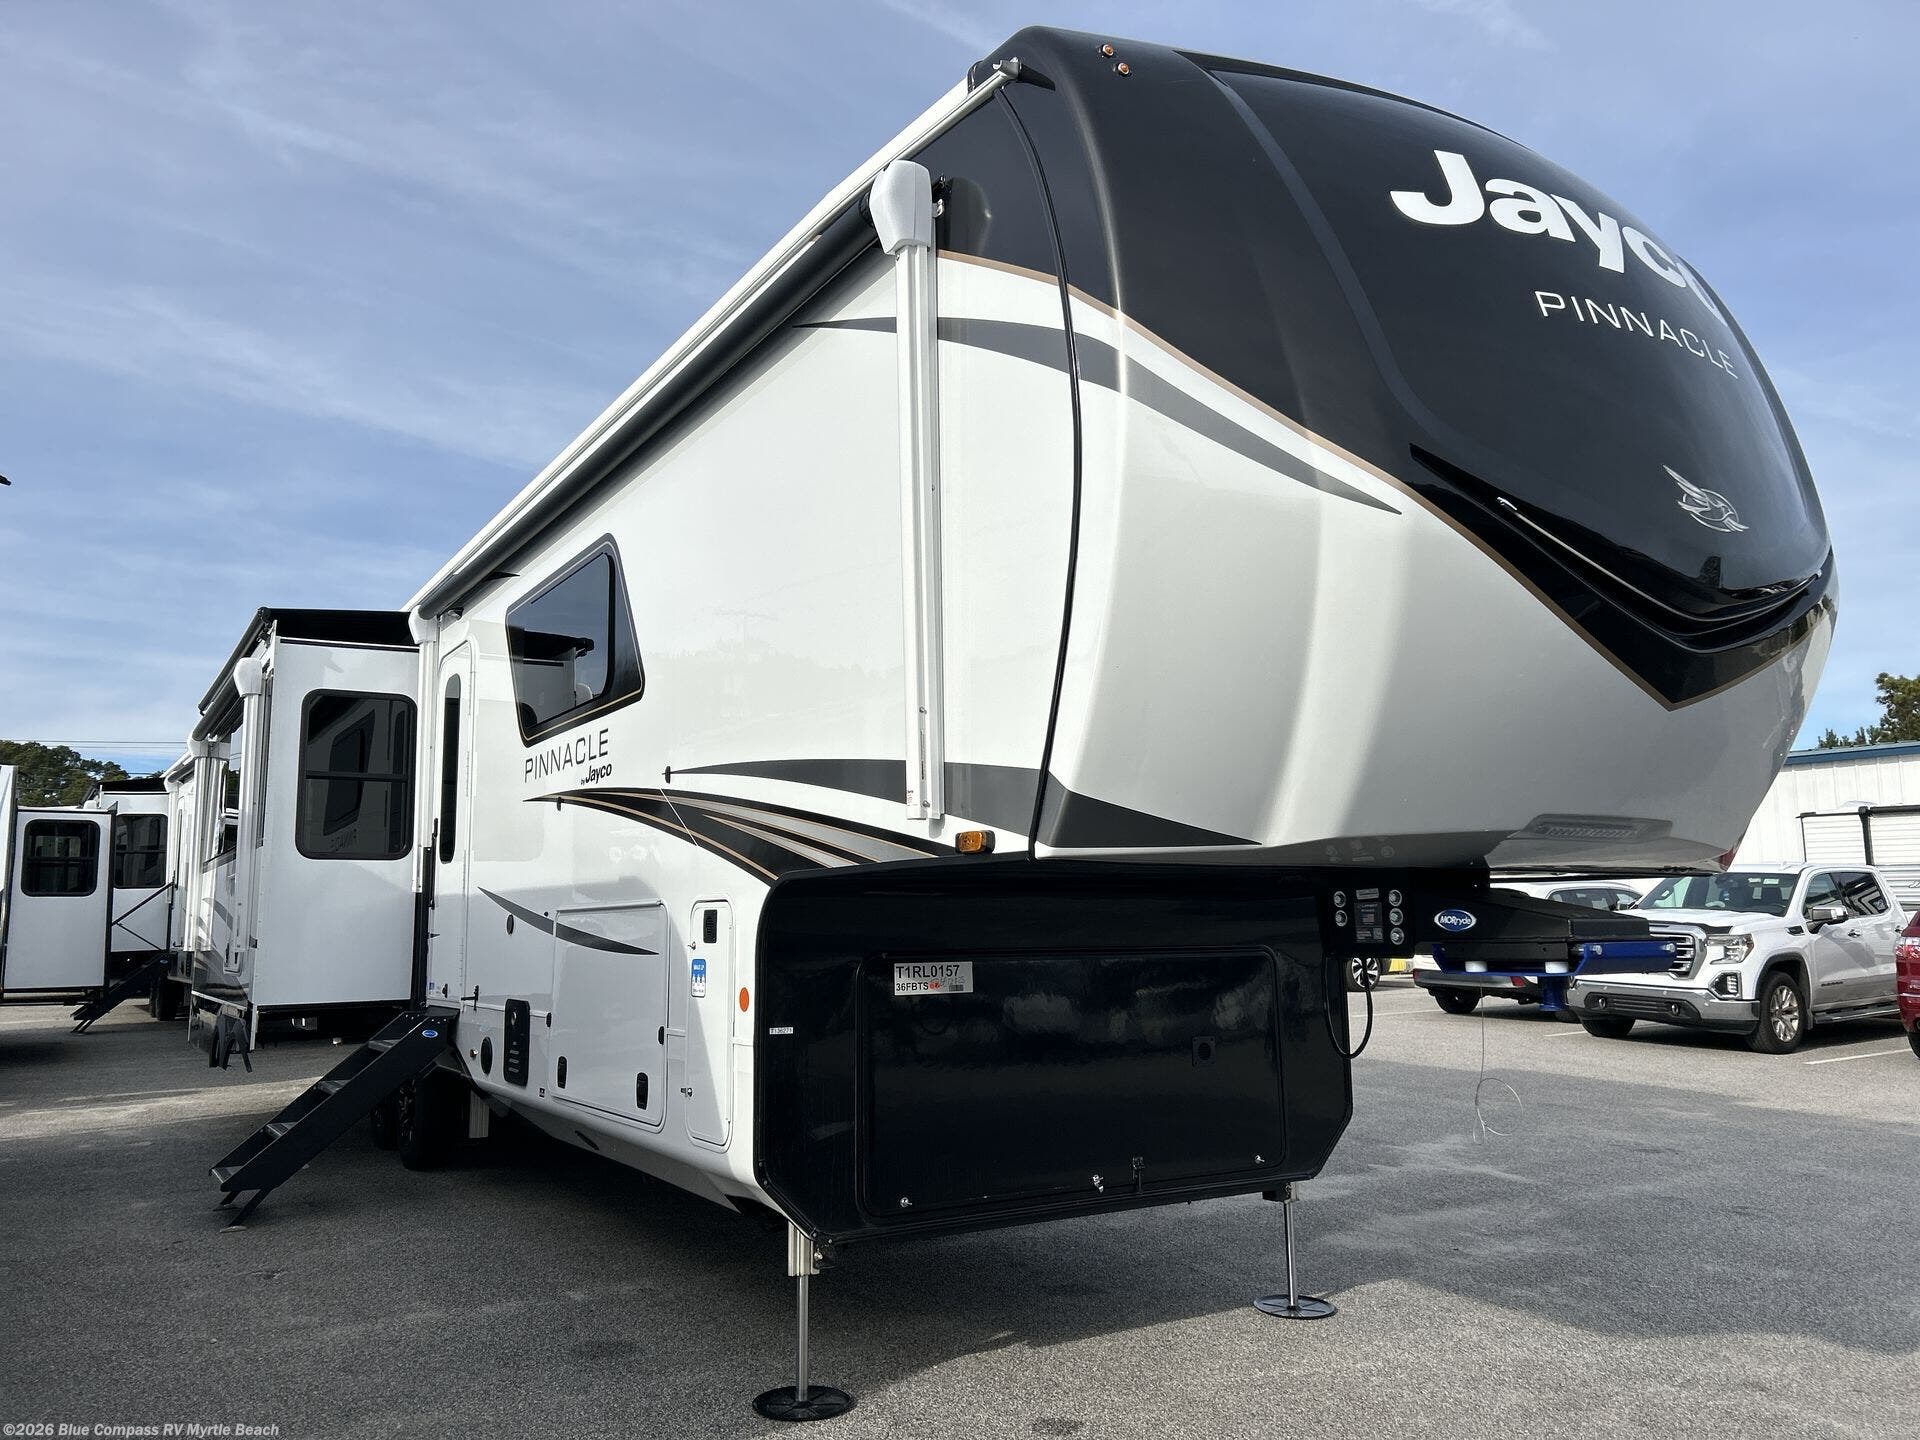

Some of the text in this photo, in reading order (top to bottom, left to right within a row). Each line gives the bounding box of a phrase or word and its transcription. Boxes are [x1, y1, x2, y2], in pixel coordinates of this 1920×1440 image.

[1534, 290, 1738, 379] PINNACLE
[524, 728, 609, 783] PINNACLE
[586, 763, 612, 784] Jayco
[895, 964, 960, 979] T1RL0157
[895, 981, 929, 992] 36FBTS
